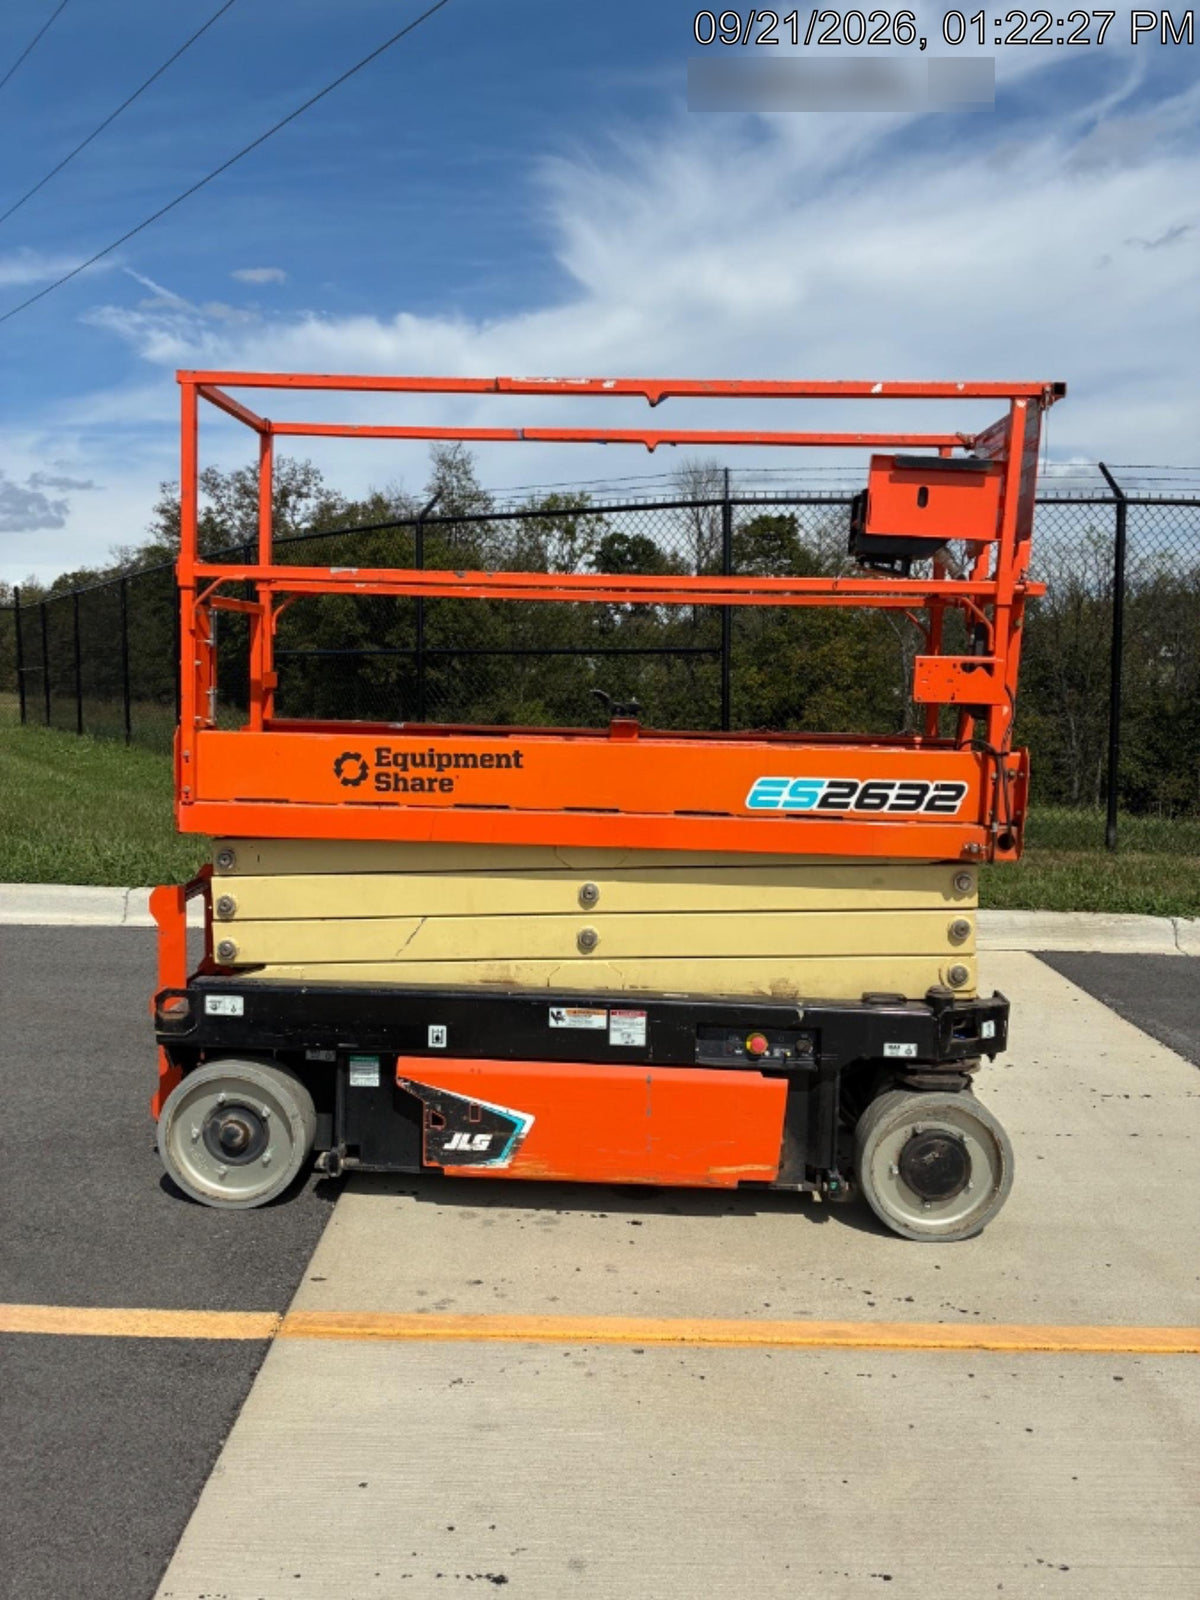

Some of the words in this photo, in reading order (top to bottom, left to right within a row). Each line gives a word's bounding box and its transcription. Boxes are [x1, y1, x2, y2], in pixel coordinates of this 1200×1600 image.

[375, 747, 524, 772] Equipment
[375, 772, 454, 792] Share
[747, 779, 967, 812] ES2632
[443, 1132, 493, 1151] JLG
